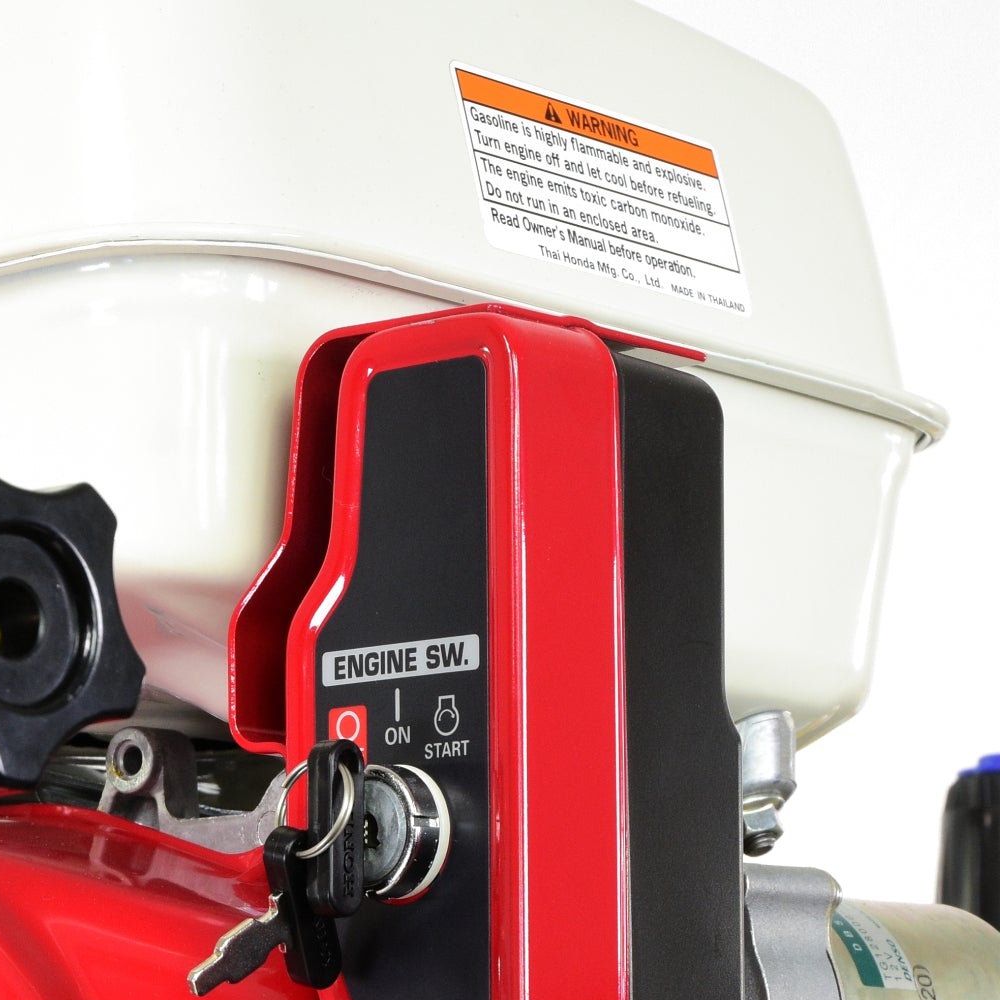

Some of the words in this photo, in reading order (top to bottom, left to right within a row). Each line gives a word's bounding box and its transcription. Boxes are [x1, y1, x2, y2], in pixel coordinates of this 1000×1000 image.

[470, 106, 519, 133] Gasoline
[521, 121, 531, 137] is
[534, 125, 567, 151] highly
[571, 137, 629, 167] flammable
[633, 160, 652, 174] and
[655, 166, 706, 191] explosive.
[566, 109, 639, 147] WARNING
[474, 129, 501, 150] Turn
[504, 142, 542, 162] engine
[545, 153, 560, 168] off
[564, 160, 584, 175] and
[587, 162, 602, 180] let
[605, 171, 627, 188] cool
[629, 176, 664, 199] before
[667, 191, 716, 217] refueling.
[480, 156, 502, 176] The
[506, 168, 544, 188] engine
[547, 181, 578, 198] emits
[580, 188, 607, 207] toxic
[610, 199, 648, 219] carbon
[651, 211, 705, 236] monoxide.
[486, 180, 502, 198] Do
[505, 190, 524, 205] not
[527, 196, 546, 211] run
[548, 199, 559, 215] in
[562, 206, 577, 220] an
[580, 211, 627, 235] enclosed
[631, 226, 659, 244] area.
[491, 207, 520, 228] Read
[522, 216, 565, 241] Owner's
[567, 228, 606, 252] Manual
[608, 240, 642, 262] before
[645, 254, 696, 278] operation.
[538, 244, 561, 260] Thai
[562, 251, 595, 270] Honda
[596, 260, 620, 278] Mfg.
[671, 283, 694, 298] MADE
[697, 290, 706, 301] IN
[707, 293, 745, 312] THAILAND
[334, 647, 417, 680] ENGINE
[426, 641, 469, 669] SW.
[384, 726, 411, 746] ON
[424, 740, 470, 760] START
[886, 938, 913, 982] DENSO
